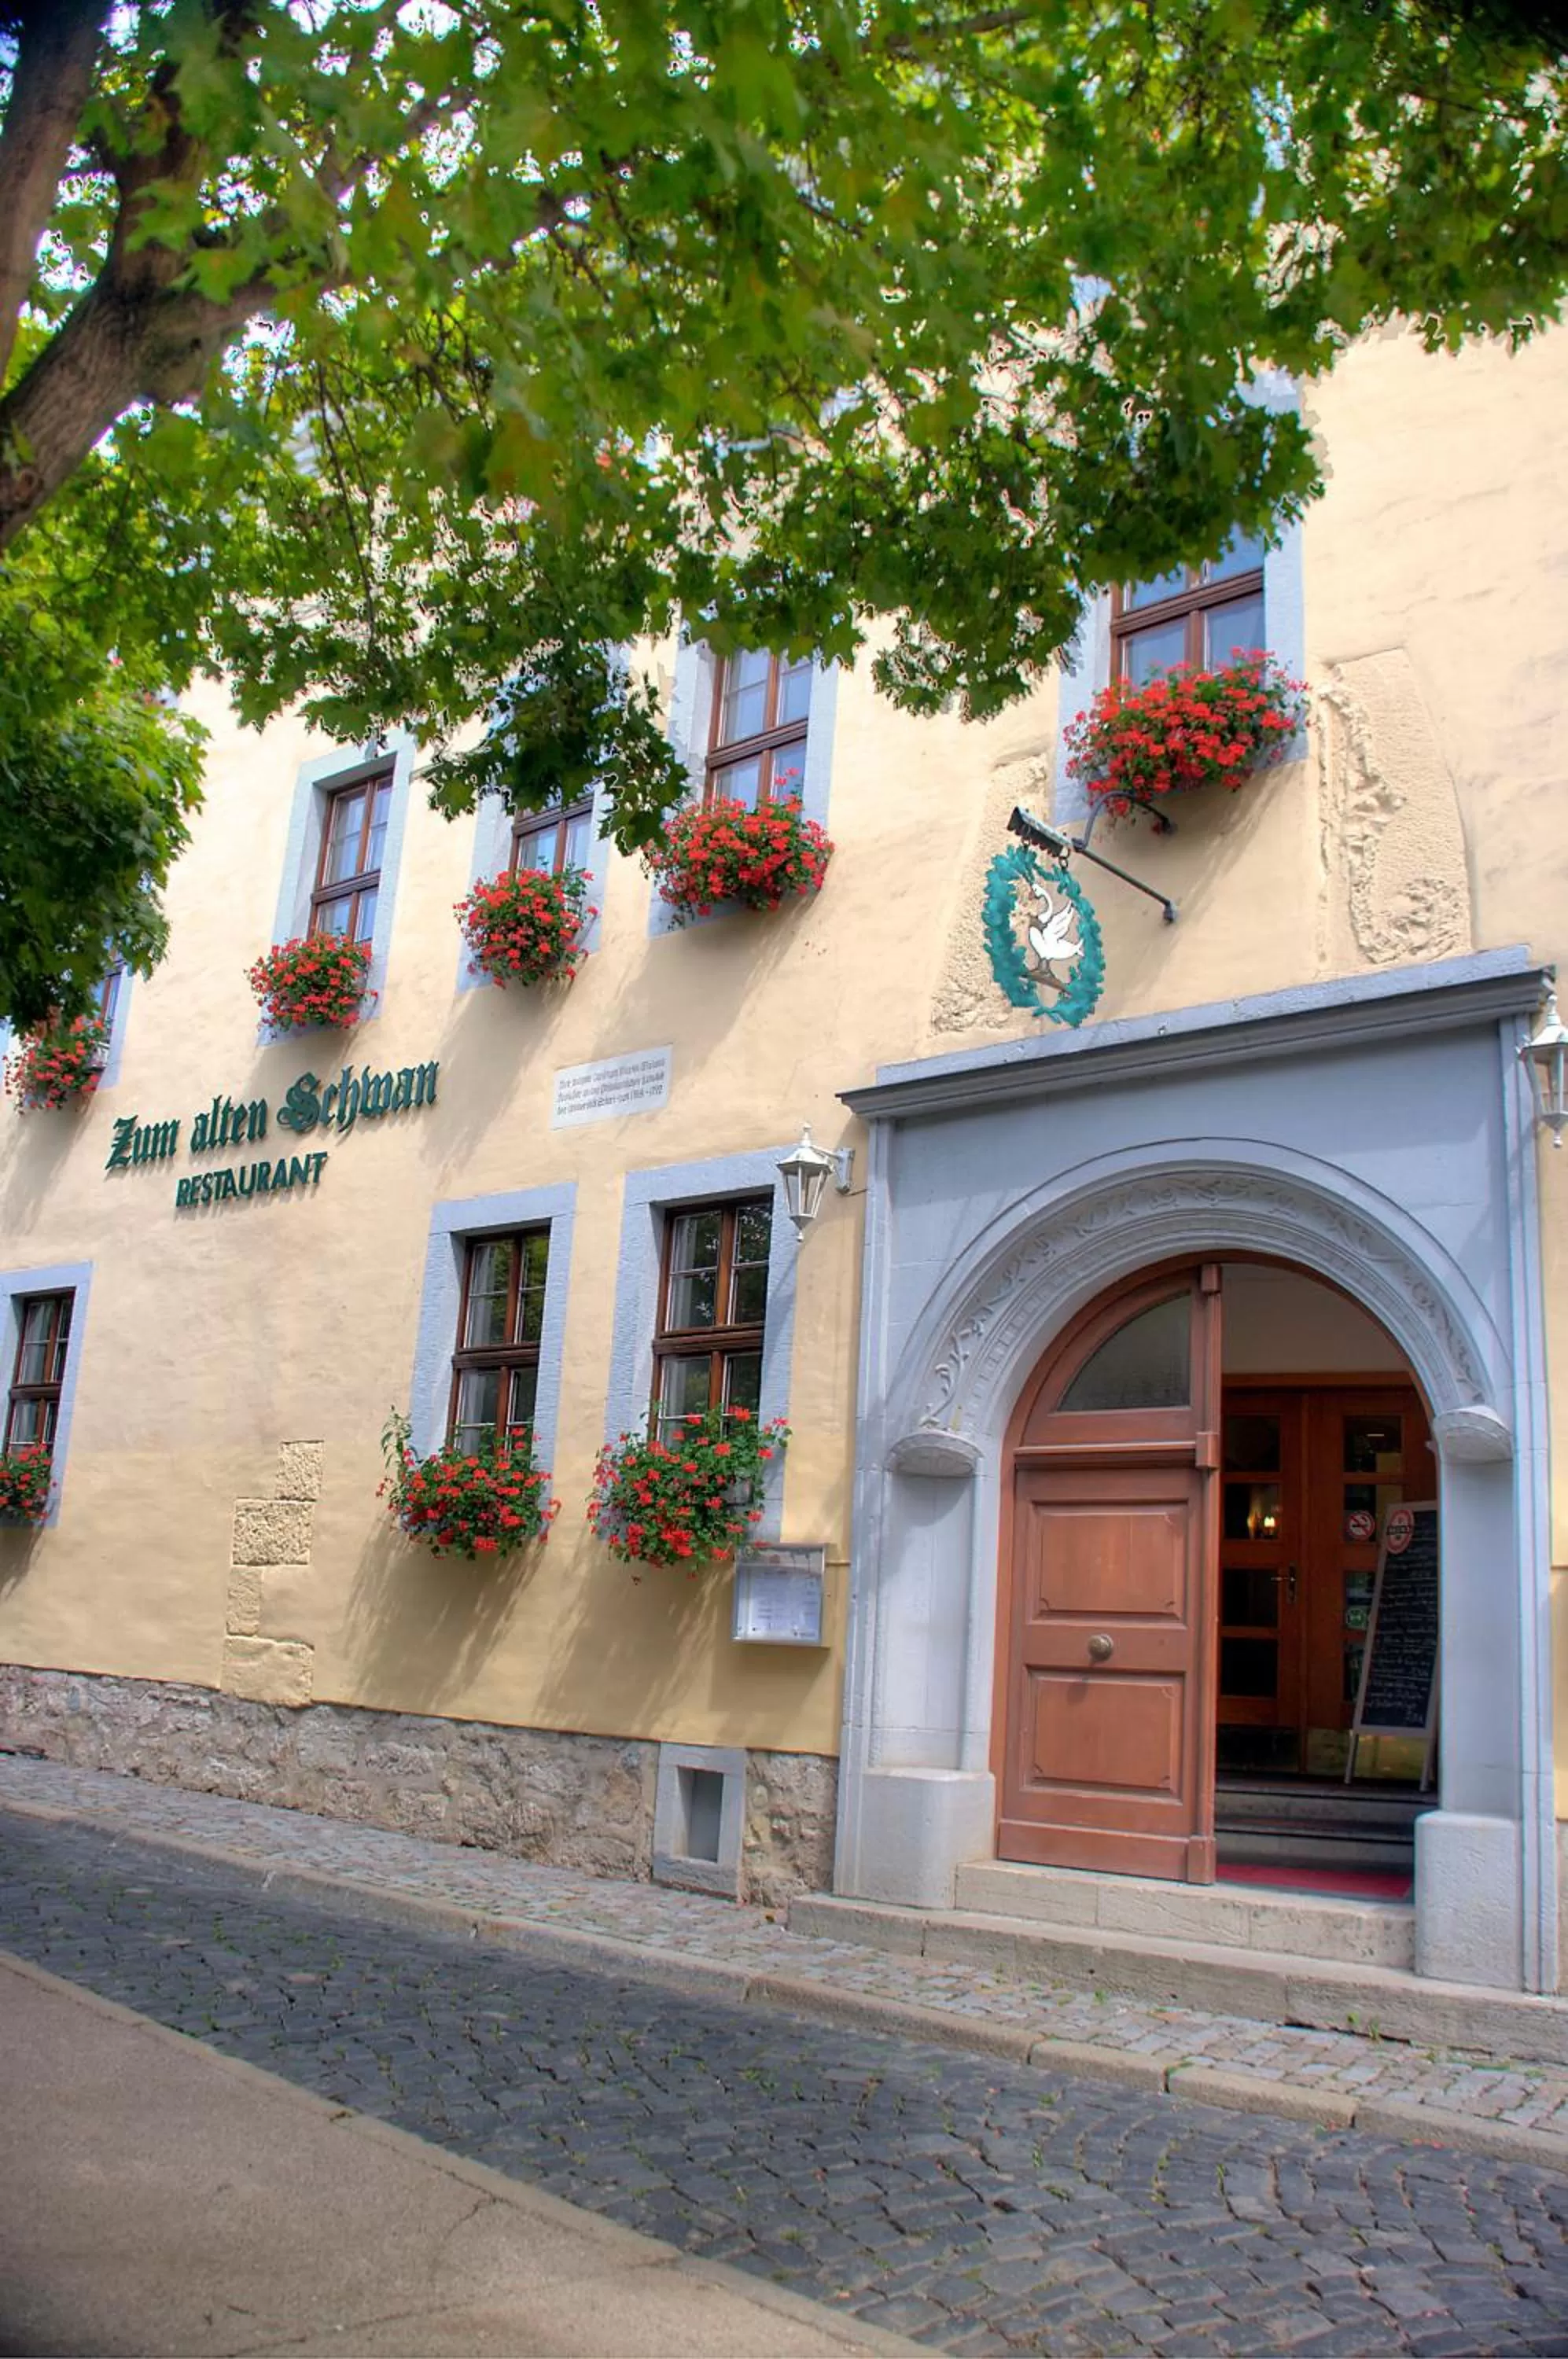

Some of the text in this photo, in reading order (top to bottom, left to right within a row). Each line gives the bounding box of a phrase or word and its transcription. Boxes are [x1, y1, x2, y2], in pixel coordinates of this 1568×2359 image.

[105, 1060, 440, 1170] Zum alten Schwan
[175, 1151, 328, 1208] RESTAURANT
